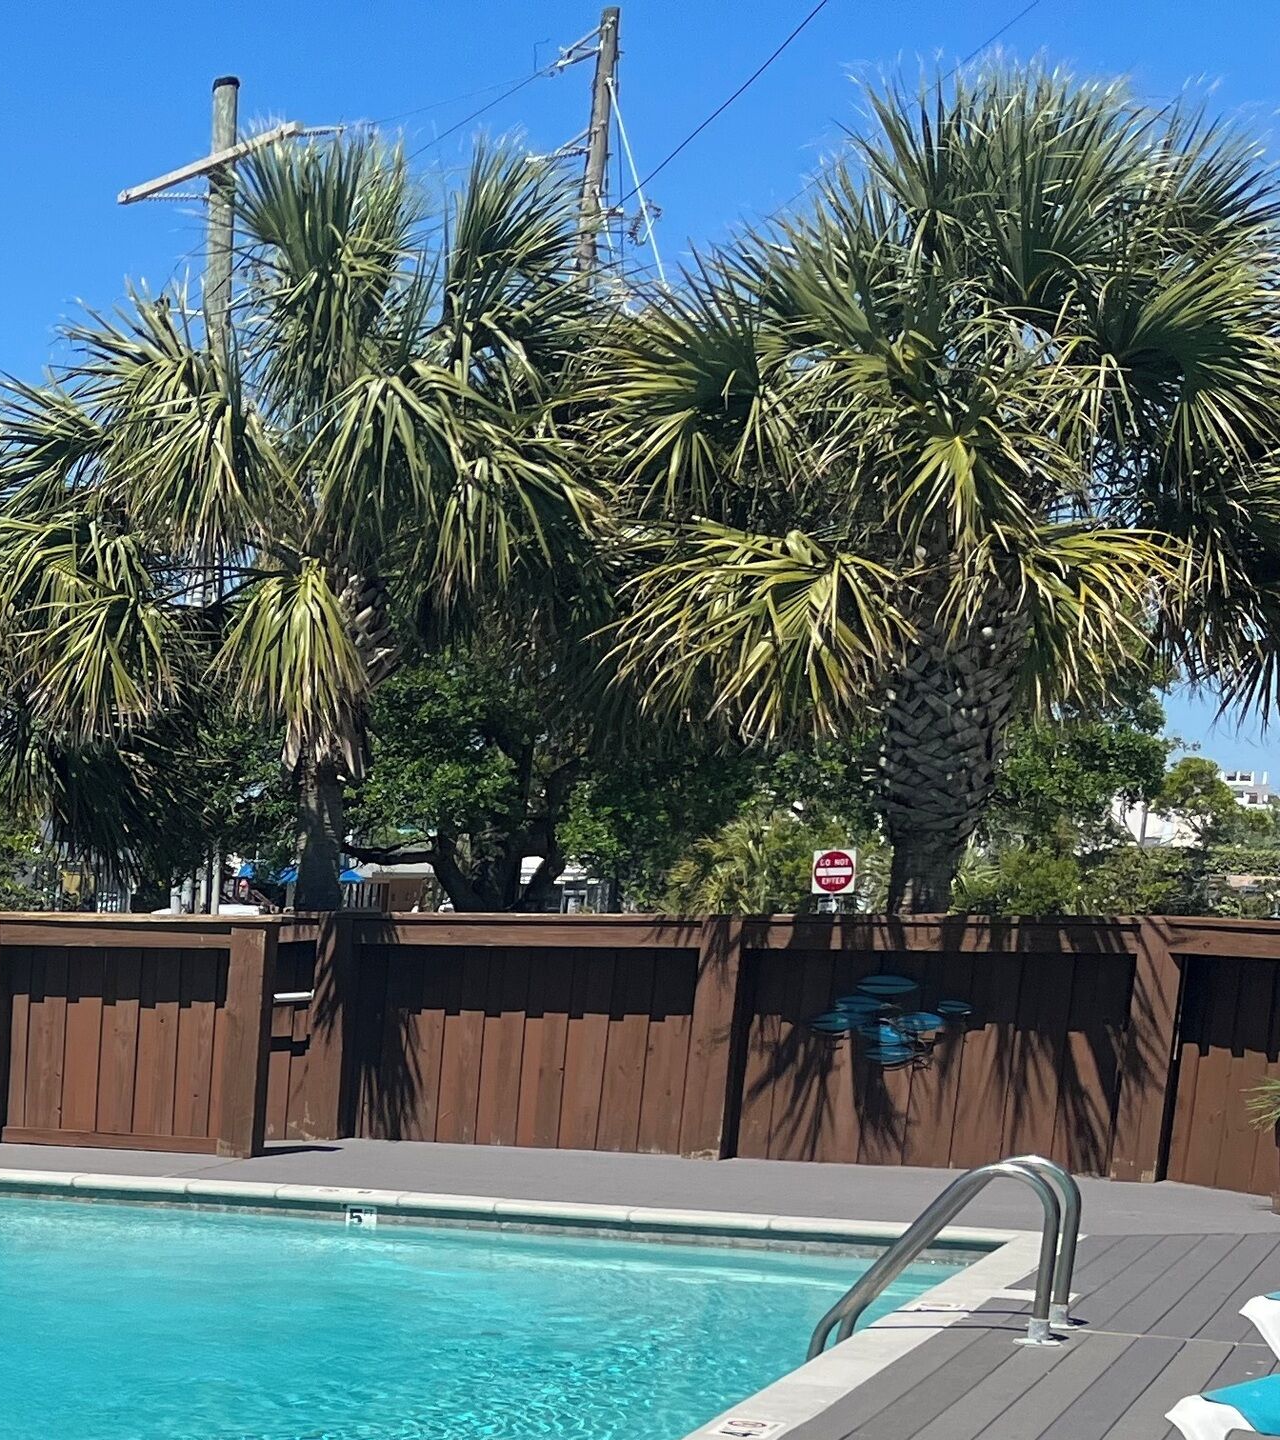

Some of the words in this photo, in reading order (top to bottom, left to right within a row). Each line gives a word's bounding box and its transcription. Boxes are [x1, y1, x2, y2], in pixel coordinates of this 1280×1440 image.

[834, 858, 850, 866] NOT
[821, 877, 845, 885] ENTER
[349, 1208, 362, 1223] 5
